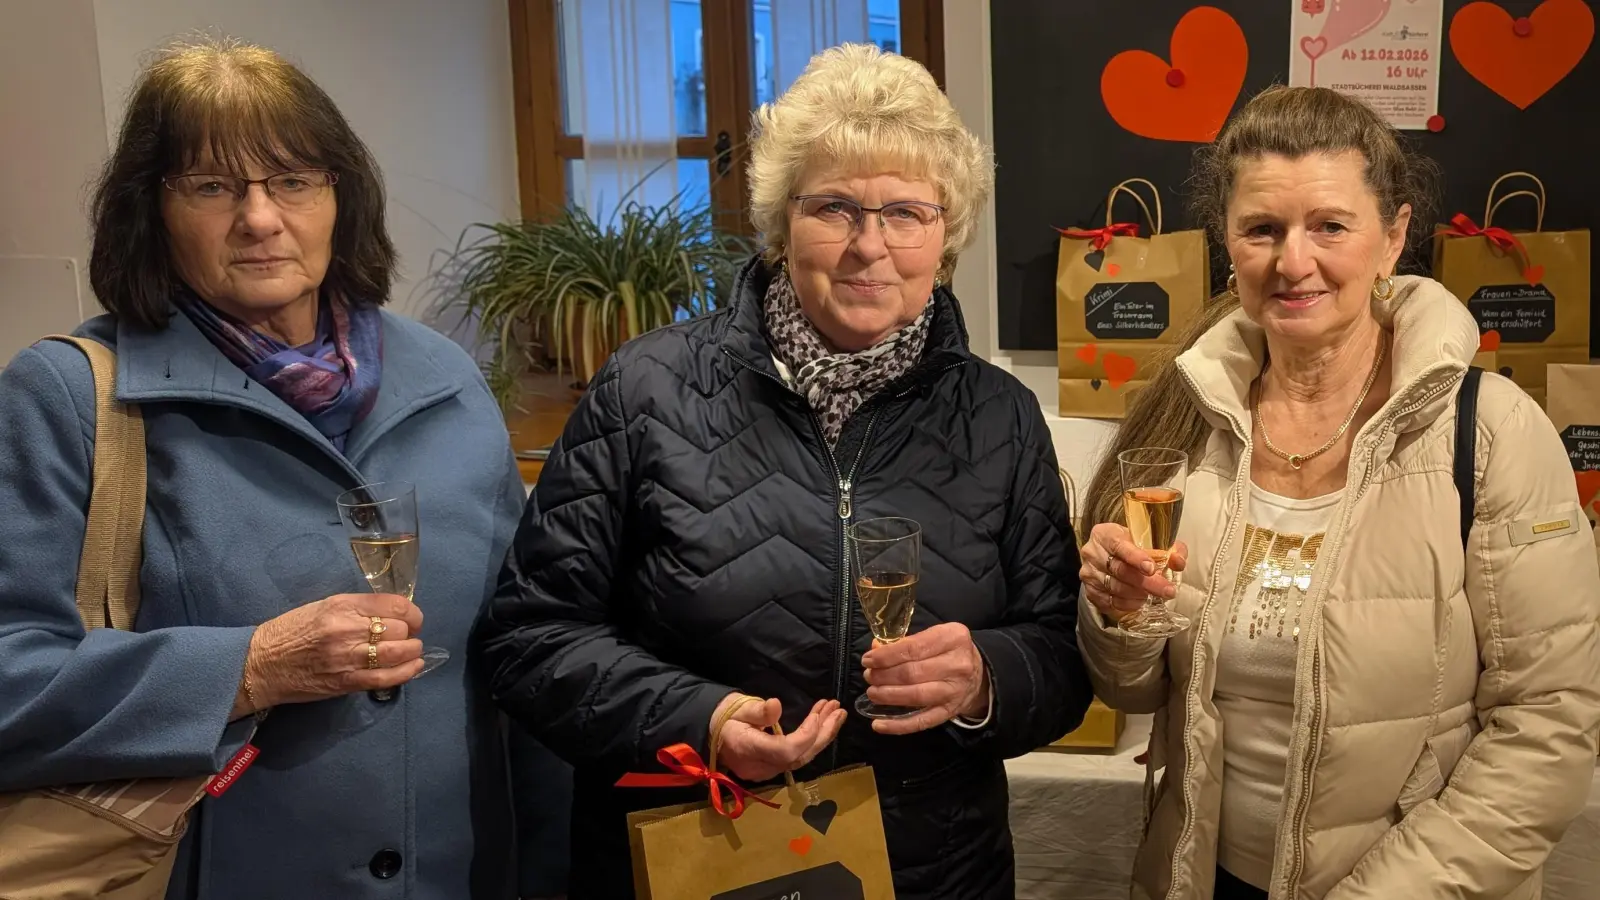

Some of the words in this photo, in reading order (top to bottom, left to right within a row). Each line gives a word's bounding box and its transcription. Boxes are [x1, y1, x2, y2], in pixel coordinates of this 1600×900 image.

[1341, 48, 1357, 60] Ab
[1360, 48, 1429, 61] 12.02.2026
[1386, 65, 1402, 78] 16
[1406, 66, 1428, 79] Uhr
[1331, 83, 1382, 91] STADTBÜCHEREI
[1089, 286, 1114, 306] Krimi
[1113, 302, 1126, 310] Ein
[1145, 302, 1154, 310] im
[1481, 309, 1499, 318] Wenn
[1500, 308, 1513, 318] ein
[1481, 319, 1499, 329] alles
[1500, 318, 1543, 329] erschüttert
[1572, 427, 1600, 436] Lebens
[1570, 450, 1583, 458] der
[212, 748, 255, 792] reisenthel
